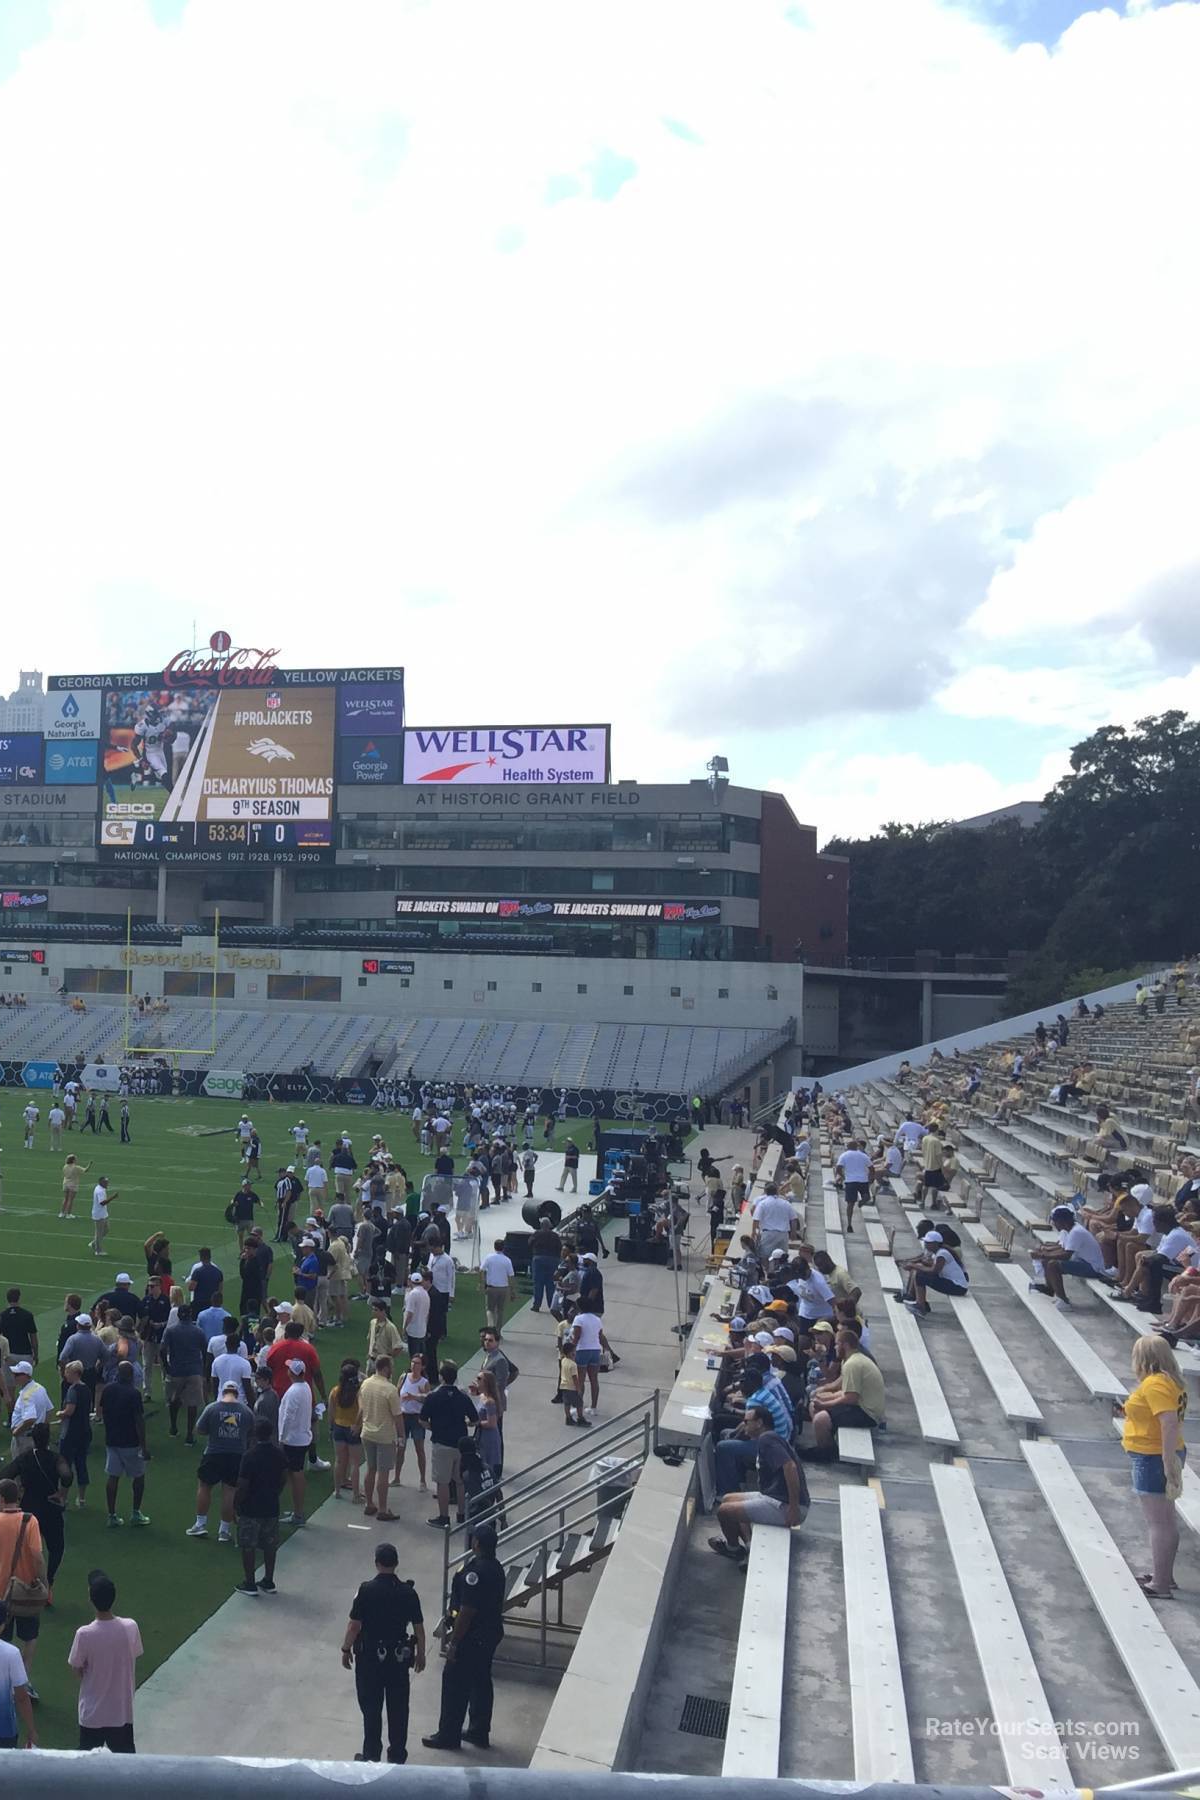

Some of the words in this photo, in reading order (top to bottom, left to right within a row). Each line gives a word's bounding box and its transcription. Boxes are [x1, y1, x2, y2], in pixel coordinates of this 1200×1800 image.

[57, 677, 112, 688] GEORGIA
[116, 676, 148, 686] TECH
[283, 671, 338, 683] YELLOW
[340, 670, 401, 682] JACKETS
[54, 720, 86, 729] Georgia
[234, 711, 313, 726] #PROJACKETS
[415, 729, 588, 759] WELLSTAR
[66, 757, 94, 767] AT&T
[352, 761, 388, 772] Georgia
[356, 771, 384, 780] Power
[502, 768, 544, 781] Health
[547, 768, 594, 783] System
[203, 779, 277, 795] DEMARYIUS
[280, 778, 334, 795] THOMAS
[4, 793, 67, 805] STADIUM
[416, 792, 437, 805] AT
[442, 792, 521, 805] HISTORIC
[525, 792, 584, 805] GRANT
[591, 792, 640, 805] FIELD
[106, 803, 155, 814] GEICO
[253, 800, 300, 815] SEASON
[145, 824, 154, 842] 0
[209, 825, 246, 841] 53:34
[255, 832, 259, 843] 1
[275, 824, 285, 842] 0
[114, 852, 160, 861] NATIONAL
[165, 852, 222, 861] CHAMPIONS
[298, 853, 320, 862] 1990
[397, 901, 412, 912] THE
[413, 901, 450, 912] JACKETS
[450, 902, 485, 913] SWARM
[486, 902, 499, 913] ON
[553, 903, 570, 914] THE
[570, 903, 609, 915] JACKETS
[610, 904, 647, 916] SWARM
[648, 905, 661, 916] ON
[121, 948, 216, 969] Georgia
[224, 951, 281, 970] Tech
[364, 961, 377, 972] 40
[207, 1077, 244, 1093] sage
